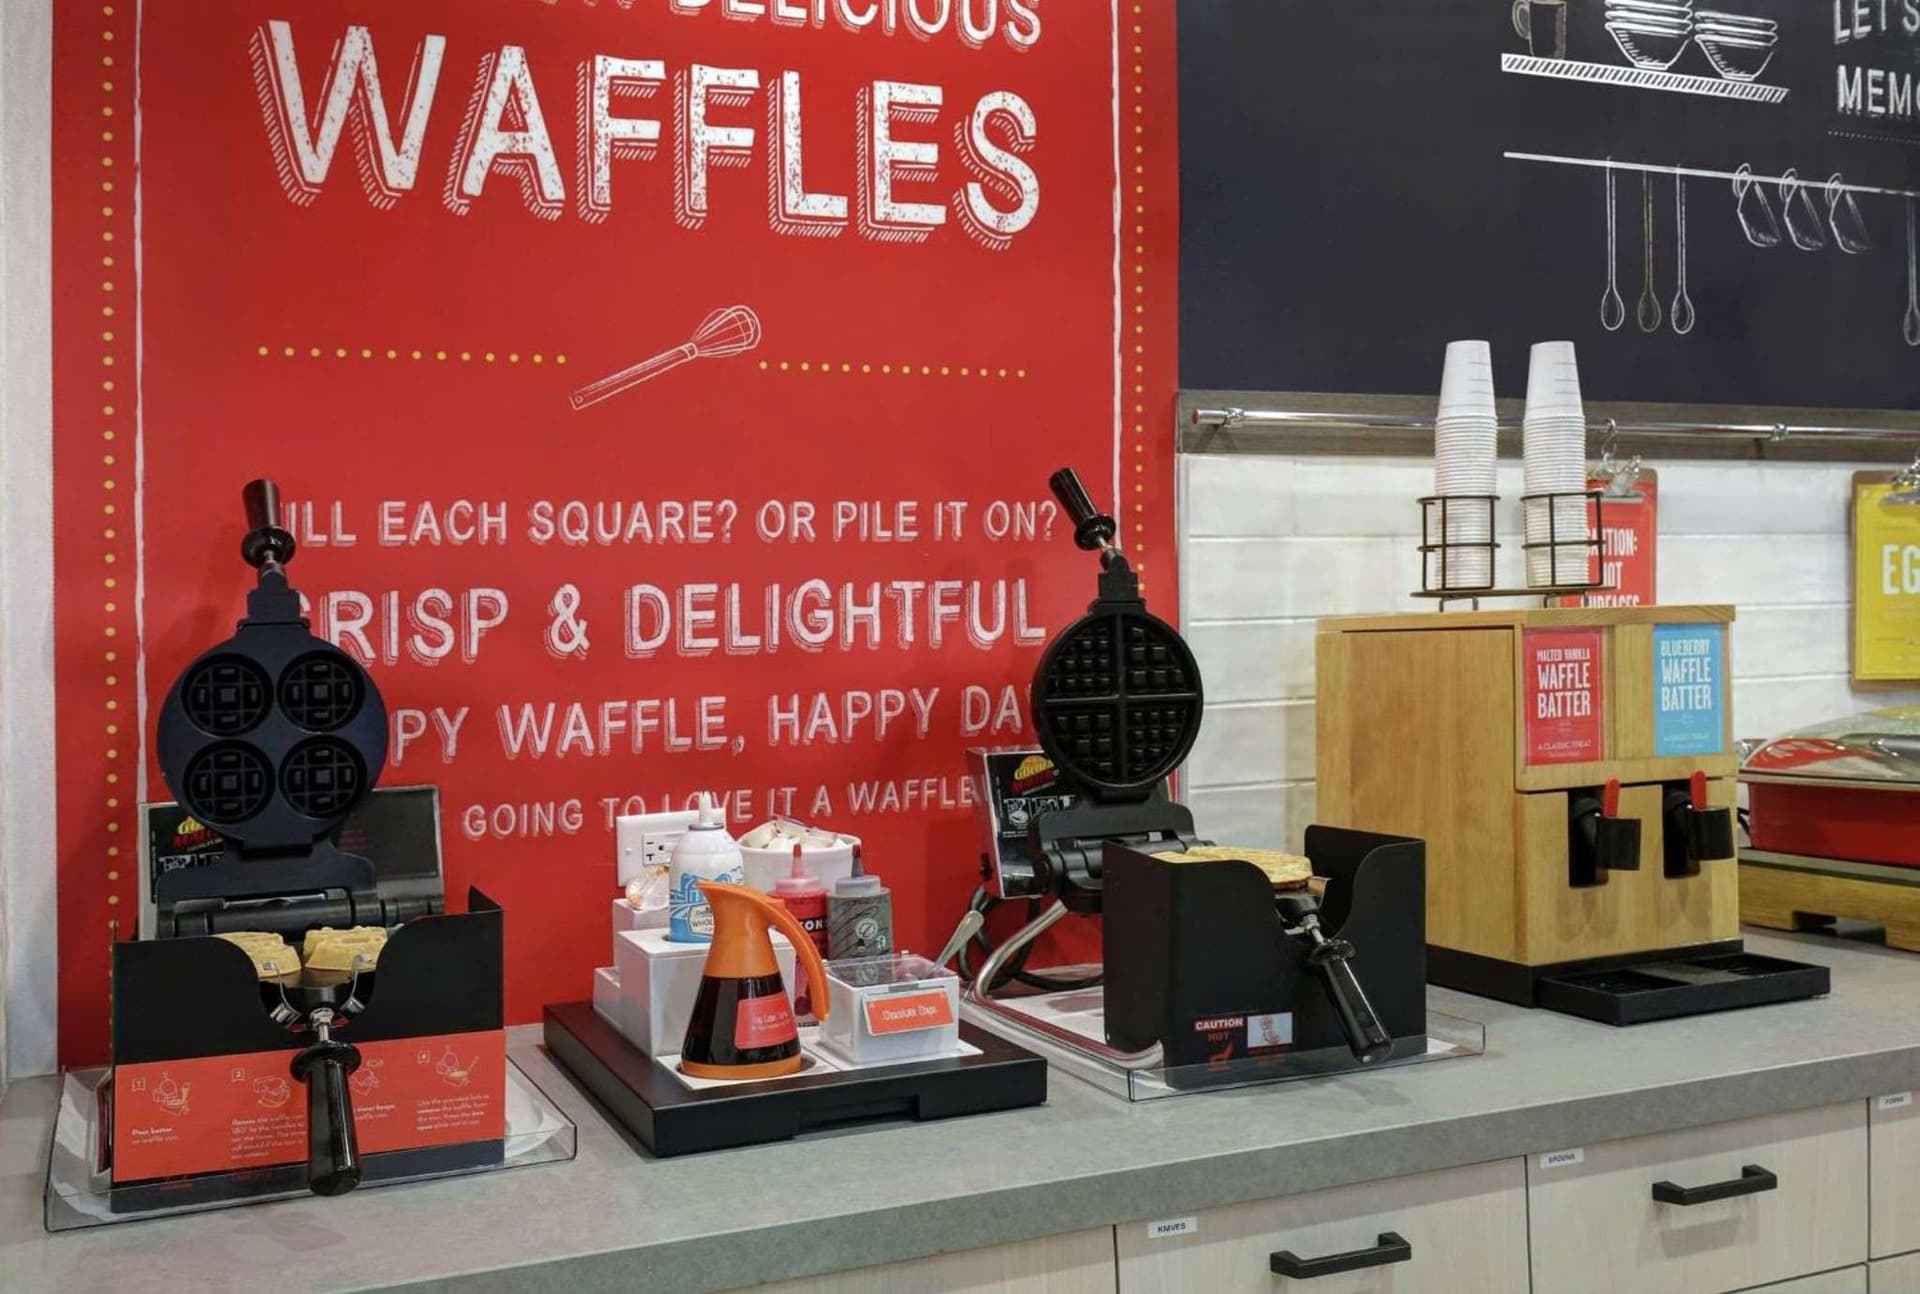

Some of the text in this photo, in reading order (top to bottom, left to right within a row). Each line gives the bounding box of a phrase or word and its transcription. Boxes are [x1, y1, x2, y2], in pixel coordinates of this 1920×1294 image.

[1834, 0, 1919, 44] LETS
[1837, 64, 1920, 117] MEM
[250, 19, 1041, 250] WAFFLES
[281, 499, 1058, 547] ILL EACH SQUARE? OR PILE IT ON?
[298, 578, 1047, 666] RISP & DELIGHTFUL
[1661, 639, 1710, 656] BLUEBERRY
[1537, 662, 1591, 690] WAFFLE
[1661, 656, 1712, 684] WAFFLE
[1537, 690, 1591, 719] BATTER
[1661, 684, 1712, 712] BATTER
[389, 684, 1033, 766] PY WAFFLE, HAPPY DA
[463, 800, 584, 840] GOING
[768, 786, 798, 818] IT
[811, 784, 833, 818] A
[849, 775, 973, 817] WAFFLE
[1195, 1017, 1244, 1031] CAUTION
